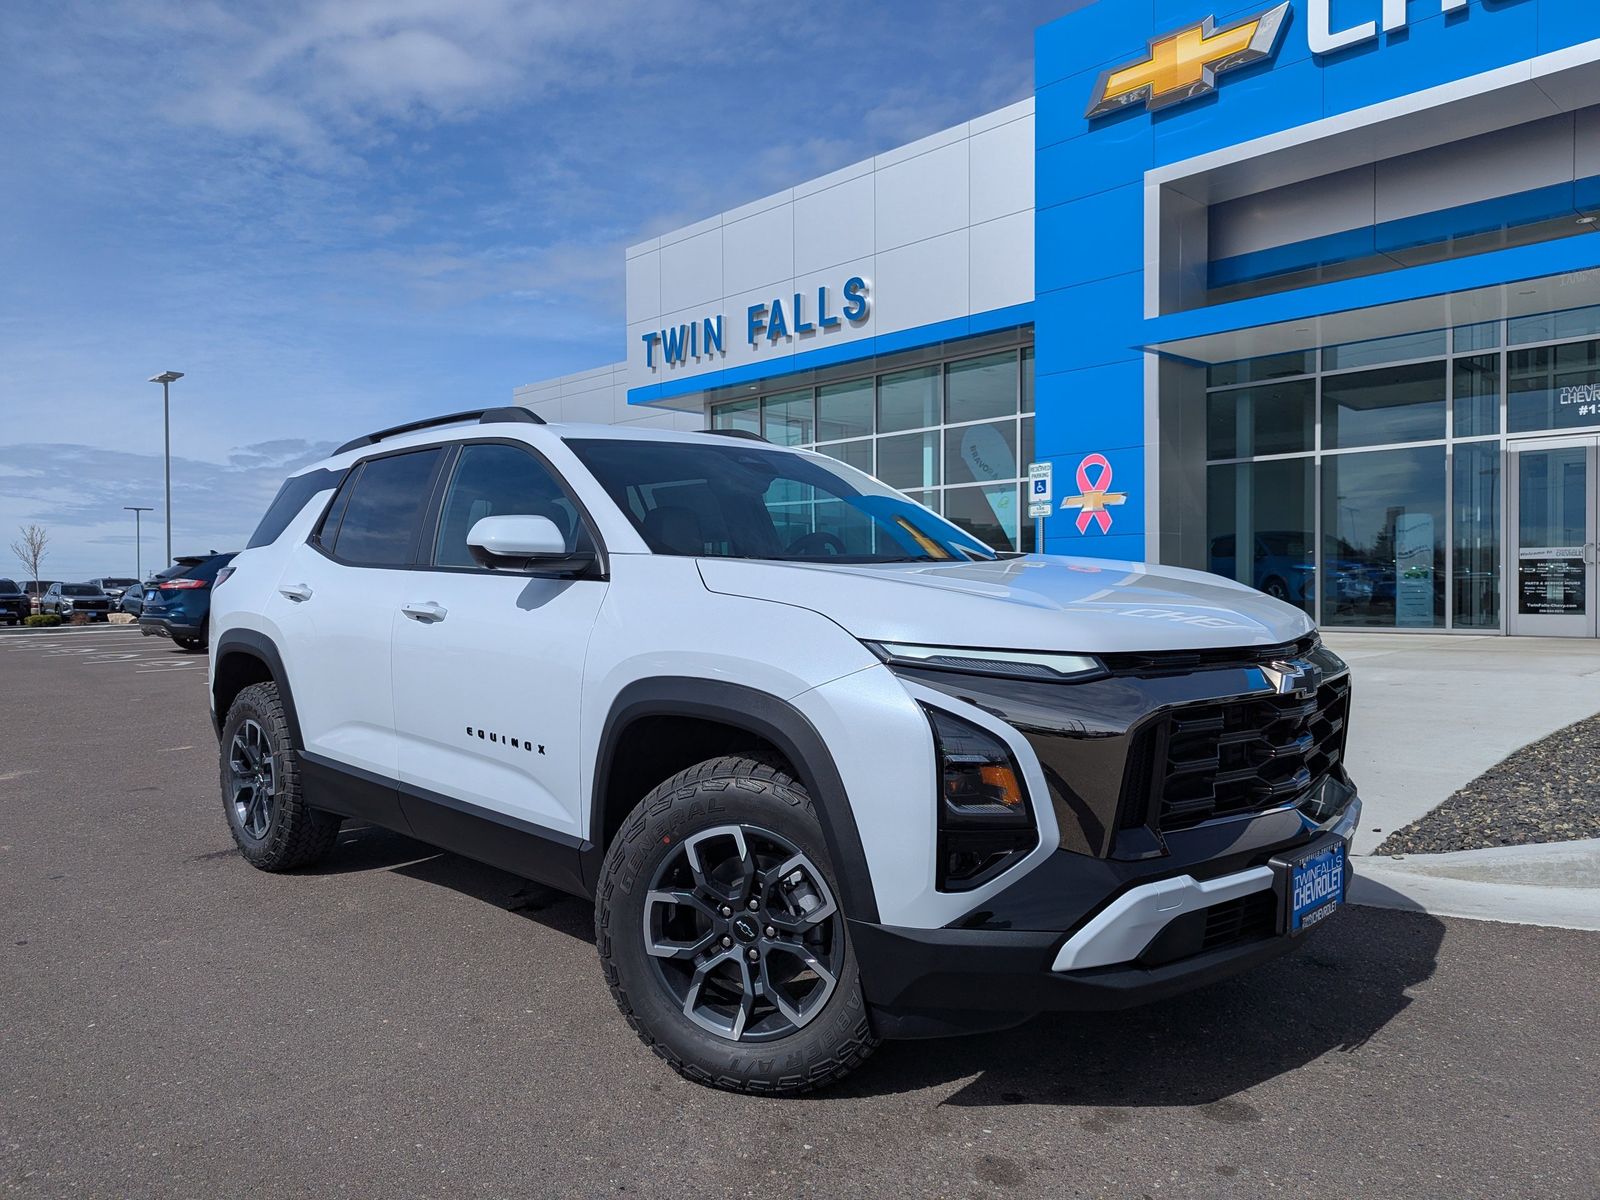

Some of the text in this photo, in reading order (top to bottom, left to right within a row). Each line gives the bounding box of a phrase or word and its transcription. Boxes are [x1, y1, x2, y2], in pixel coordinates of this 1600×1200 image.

[642, 277, 869, 368] TWIN FALLS
[1579, 404, 1600, 415] #1
[466, 726, 546, 756] EQUINOX
[619, 798, 726, 896] GENERAL
[1293, 867, 1342, 911] CHEVROLET
[1294, 855, 1342, 889] TWINFALLS
